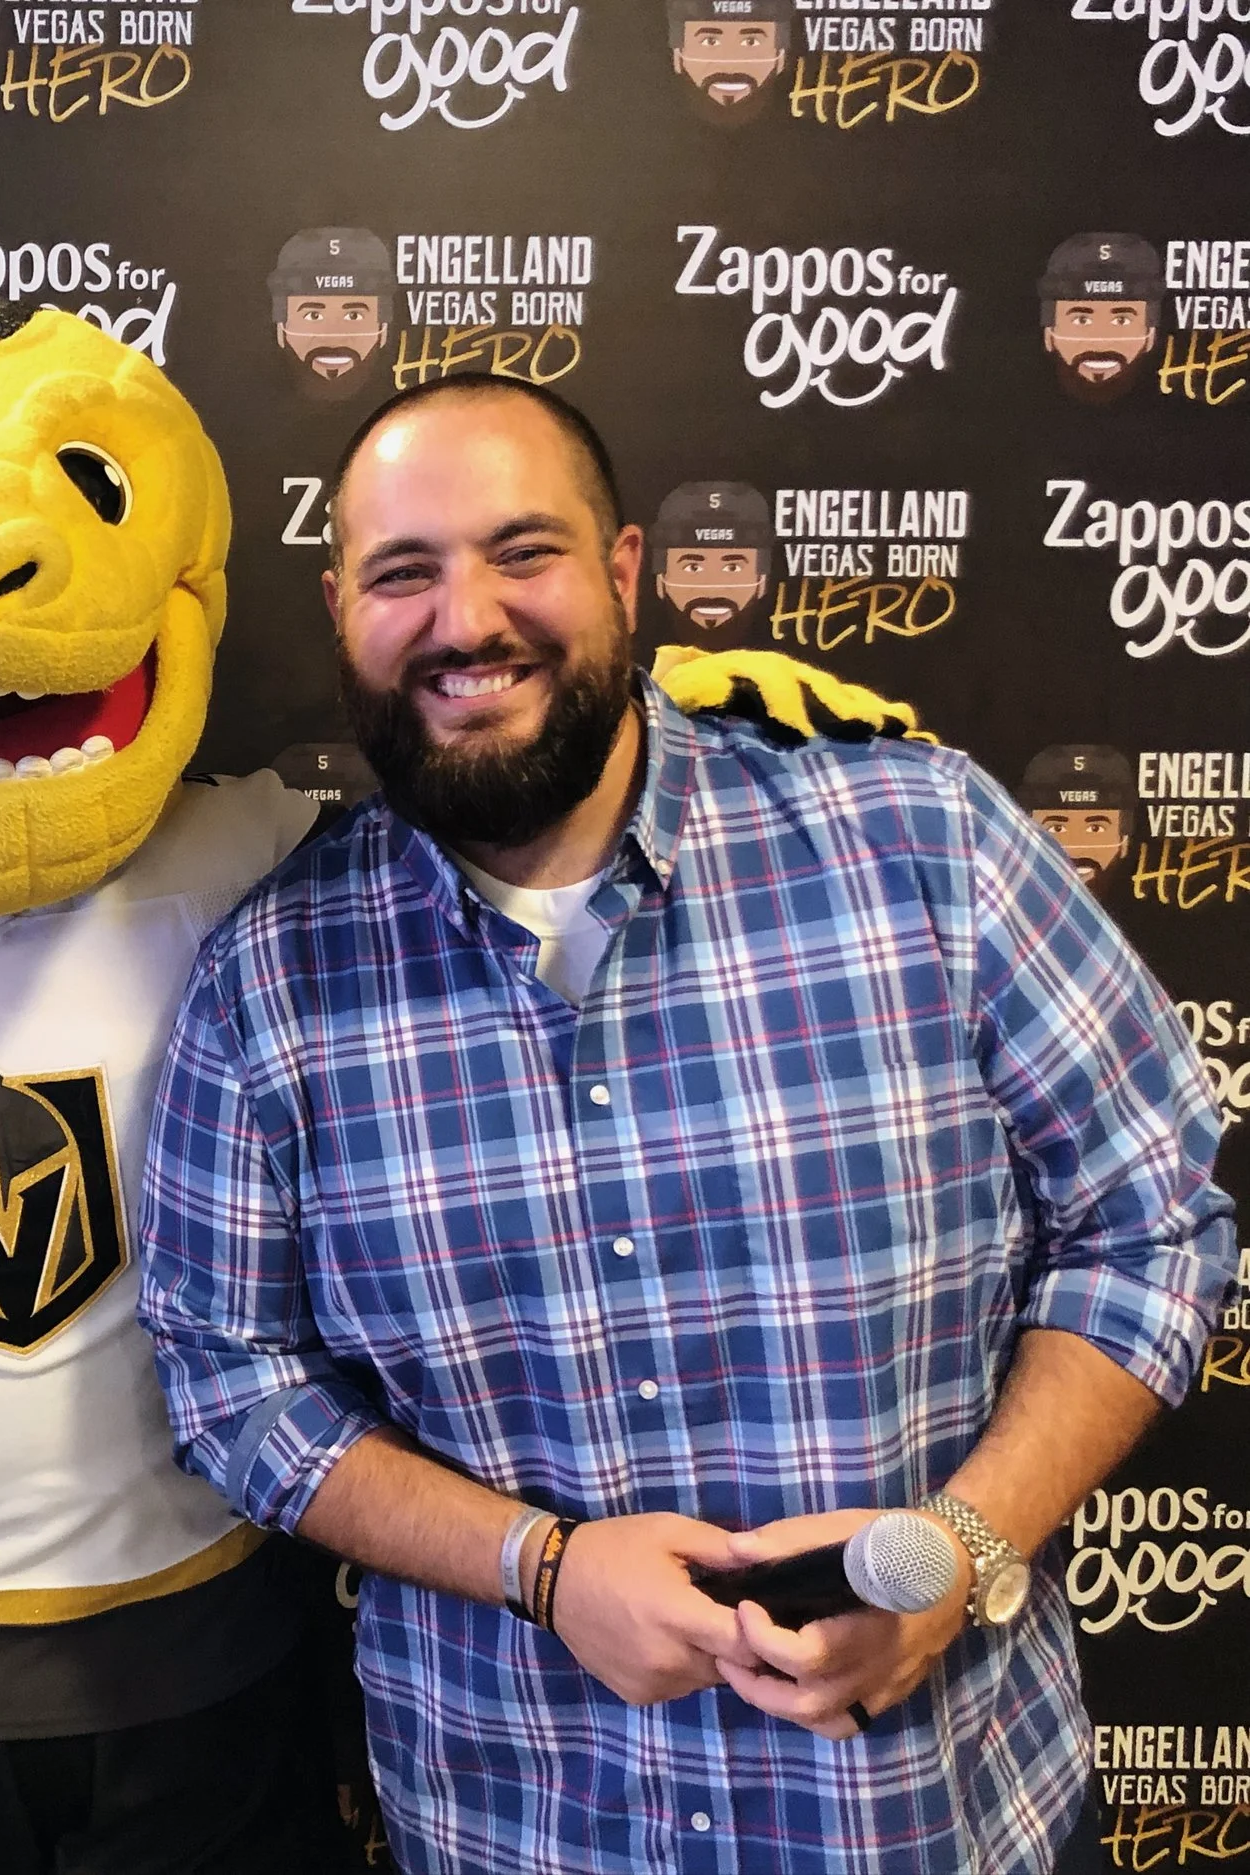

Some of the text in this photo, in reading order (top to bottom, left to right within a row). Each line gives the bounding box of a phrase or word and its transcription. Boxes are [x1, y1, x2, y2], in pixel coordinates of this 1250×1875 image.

[13, 10, 192, 44] VEGAS BORN
[804, 16, 982, 51] VEGAS BORN
[0, 43, 191, 122] HERO
[363, 7, 579, 131] good
[789, 48, 980, 130] HERO
[329, 240, 340, 255] 5
[397, 236, 592, 284] ENGELLAND
[116, 262, 166, 290] for
[316, 276, 354, 288] VEGAS
[675, 225, 947, 313] Zappos for
[1085, 281, 1123, 292] VEGAS
[407, 291, 582, 325] VEGAS BORN
[1175, 296, 1250, 329] VEGA
[744, 287, 957, 408] good
[709, 494, 720, 508] 5
[775, 490, 968, 538] ENGELLAND
[695, 529, 733, 541] VEGAS
[785, 544, 958, 577] VEGAS BORN
[771, 575, 956, 650] HERO
[1110, 559, 1250, 658] goo
[1060, 791, 1098, 802] VEGAS
[1147, 805, 1235, 837] VEGAS
[1094, 1725, 1250, 1769] ENGELLAN
[1103, 1775, 1250, 1805] VEGAS BOR
